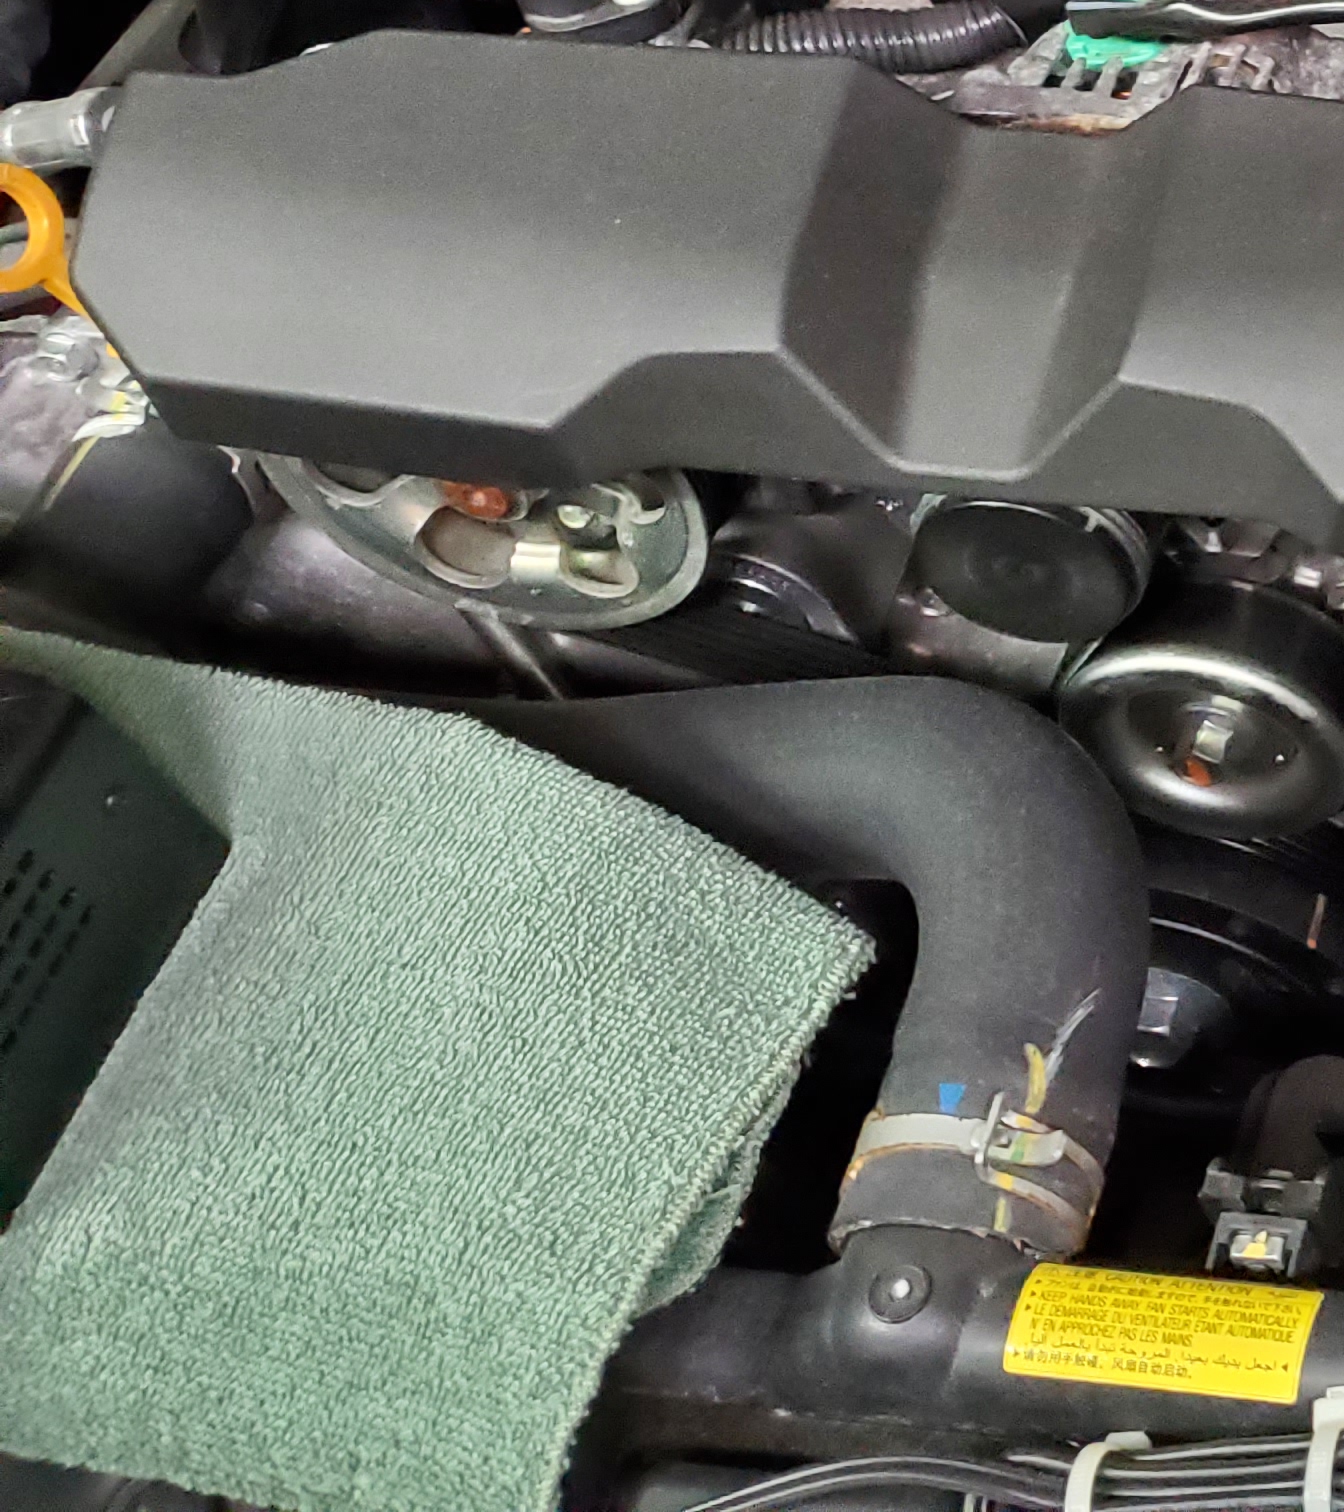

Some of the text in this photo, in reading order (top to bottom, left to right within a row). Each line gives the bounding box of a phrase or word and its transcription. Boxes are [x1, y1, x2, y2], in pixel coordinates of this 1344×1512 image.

[1167, 1279, 1252, 1296] ATTENTION
[1040, 1290, 1067, 1302] KEEP
[1070, 1293, 1109, 1307] HANDS
[1146, 1299, 1166, 1314] FAN
[1168, 1304, 1209, 1318] STARTS
[1034, 1304, 1046, 1315] LE
[1112, 1311, 1126, 1324] DU
[1129, 1313, 1192, 1332] VENTILATEUR
[1059, 1322, 1117, 1338] APPROCHEZ
[1119, 1327, 1137, 1341] PAS
[1139, 1330, 1158, 1343] LES
